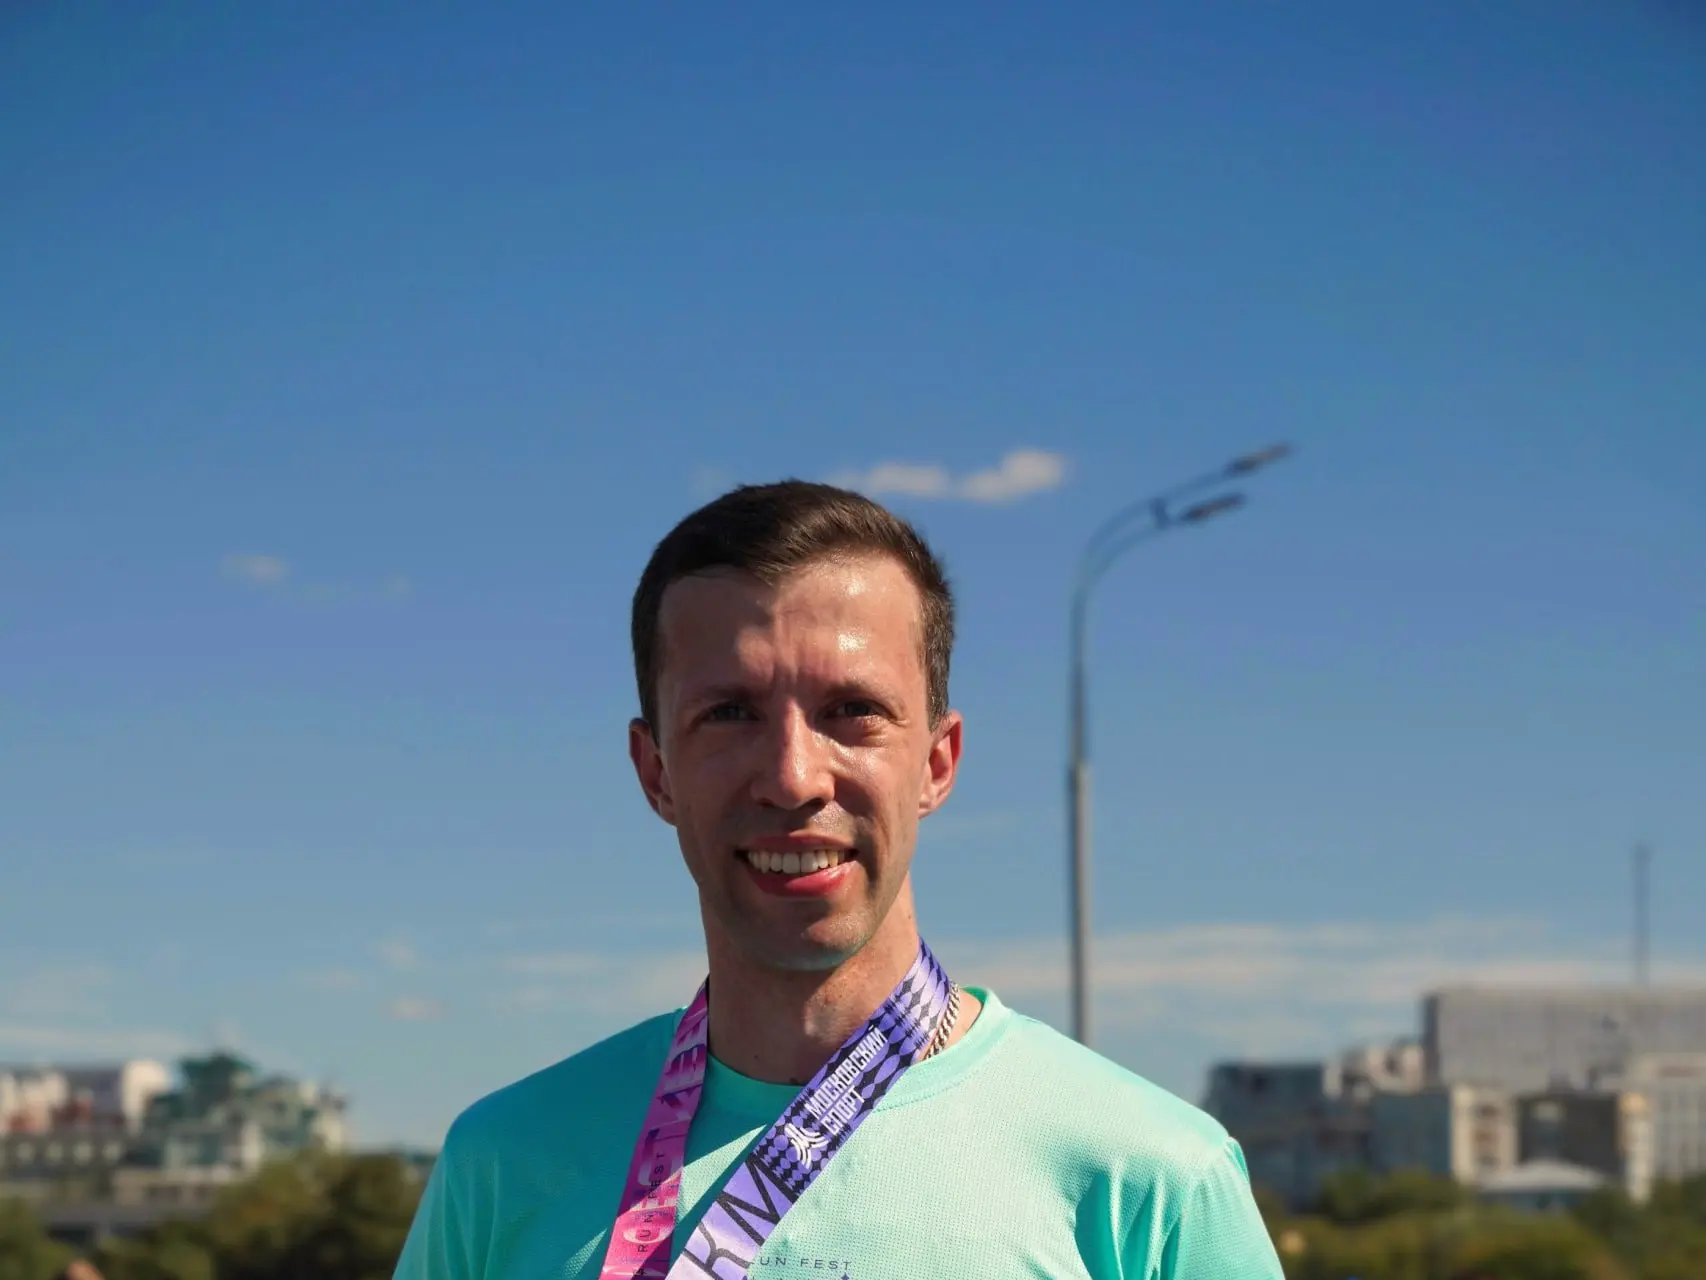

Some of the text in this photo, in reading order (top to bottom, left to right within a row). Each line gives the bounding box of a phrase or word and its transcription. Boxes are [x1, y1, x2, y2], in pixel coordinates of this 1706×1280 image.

[804, 1024, 888, 1120] МОСКОВСКИЙ
[821, 1085, 865, 1136] СПОРТ
[637, 1214, 653, 1253] RUN
[648, 1152, 664, 1200] FEST
[757, 1256, 852, 1270] UN FEST
